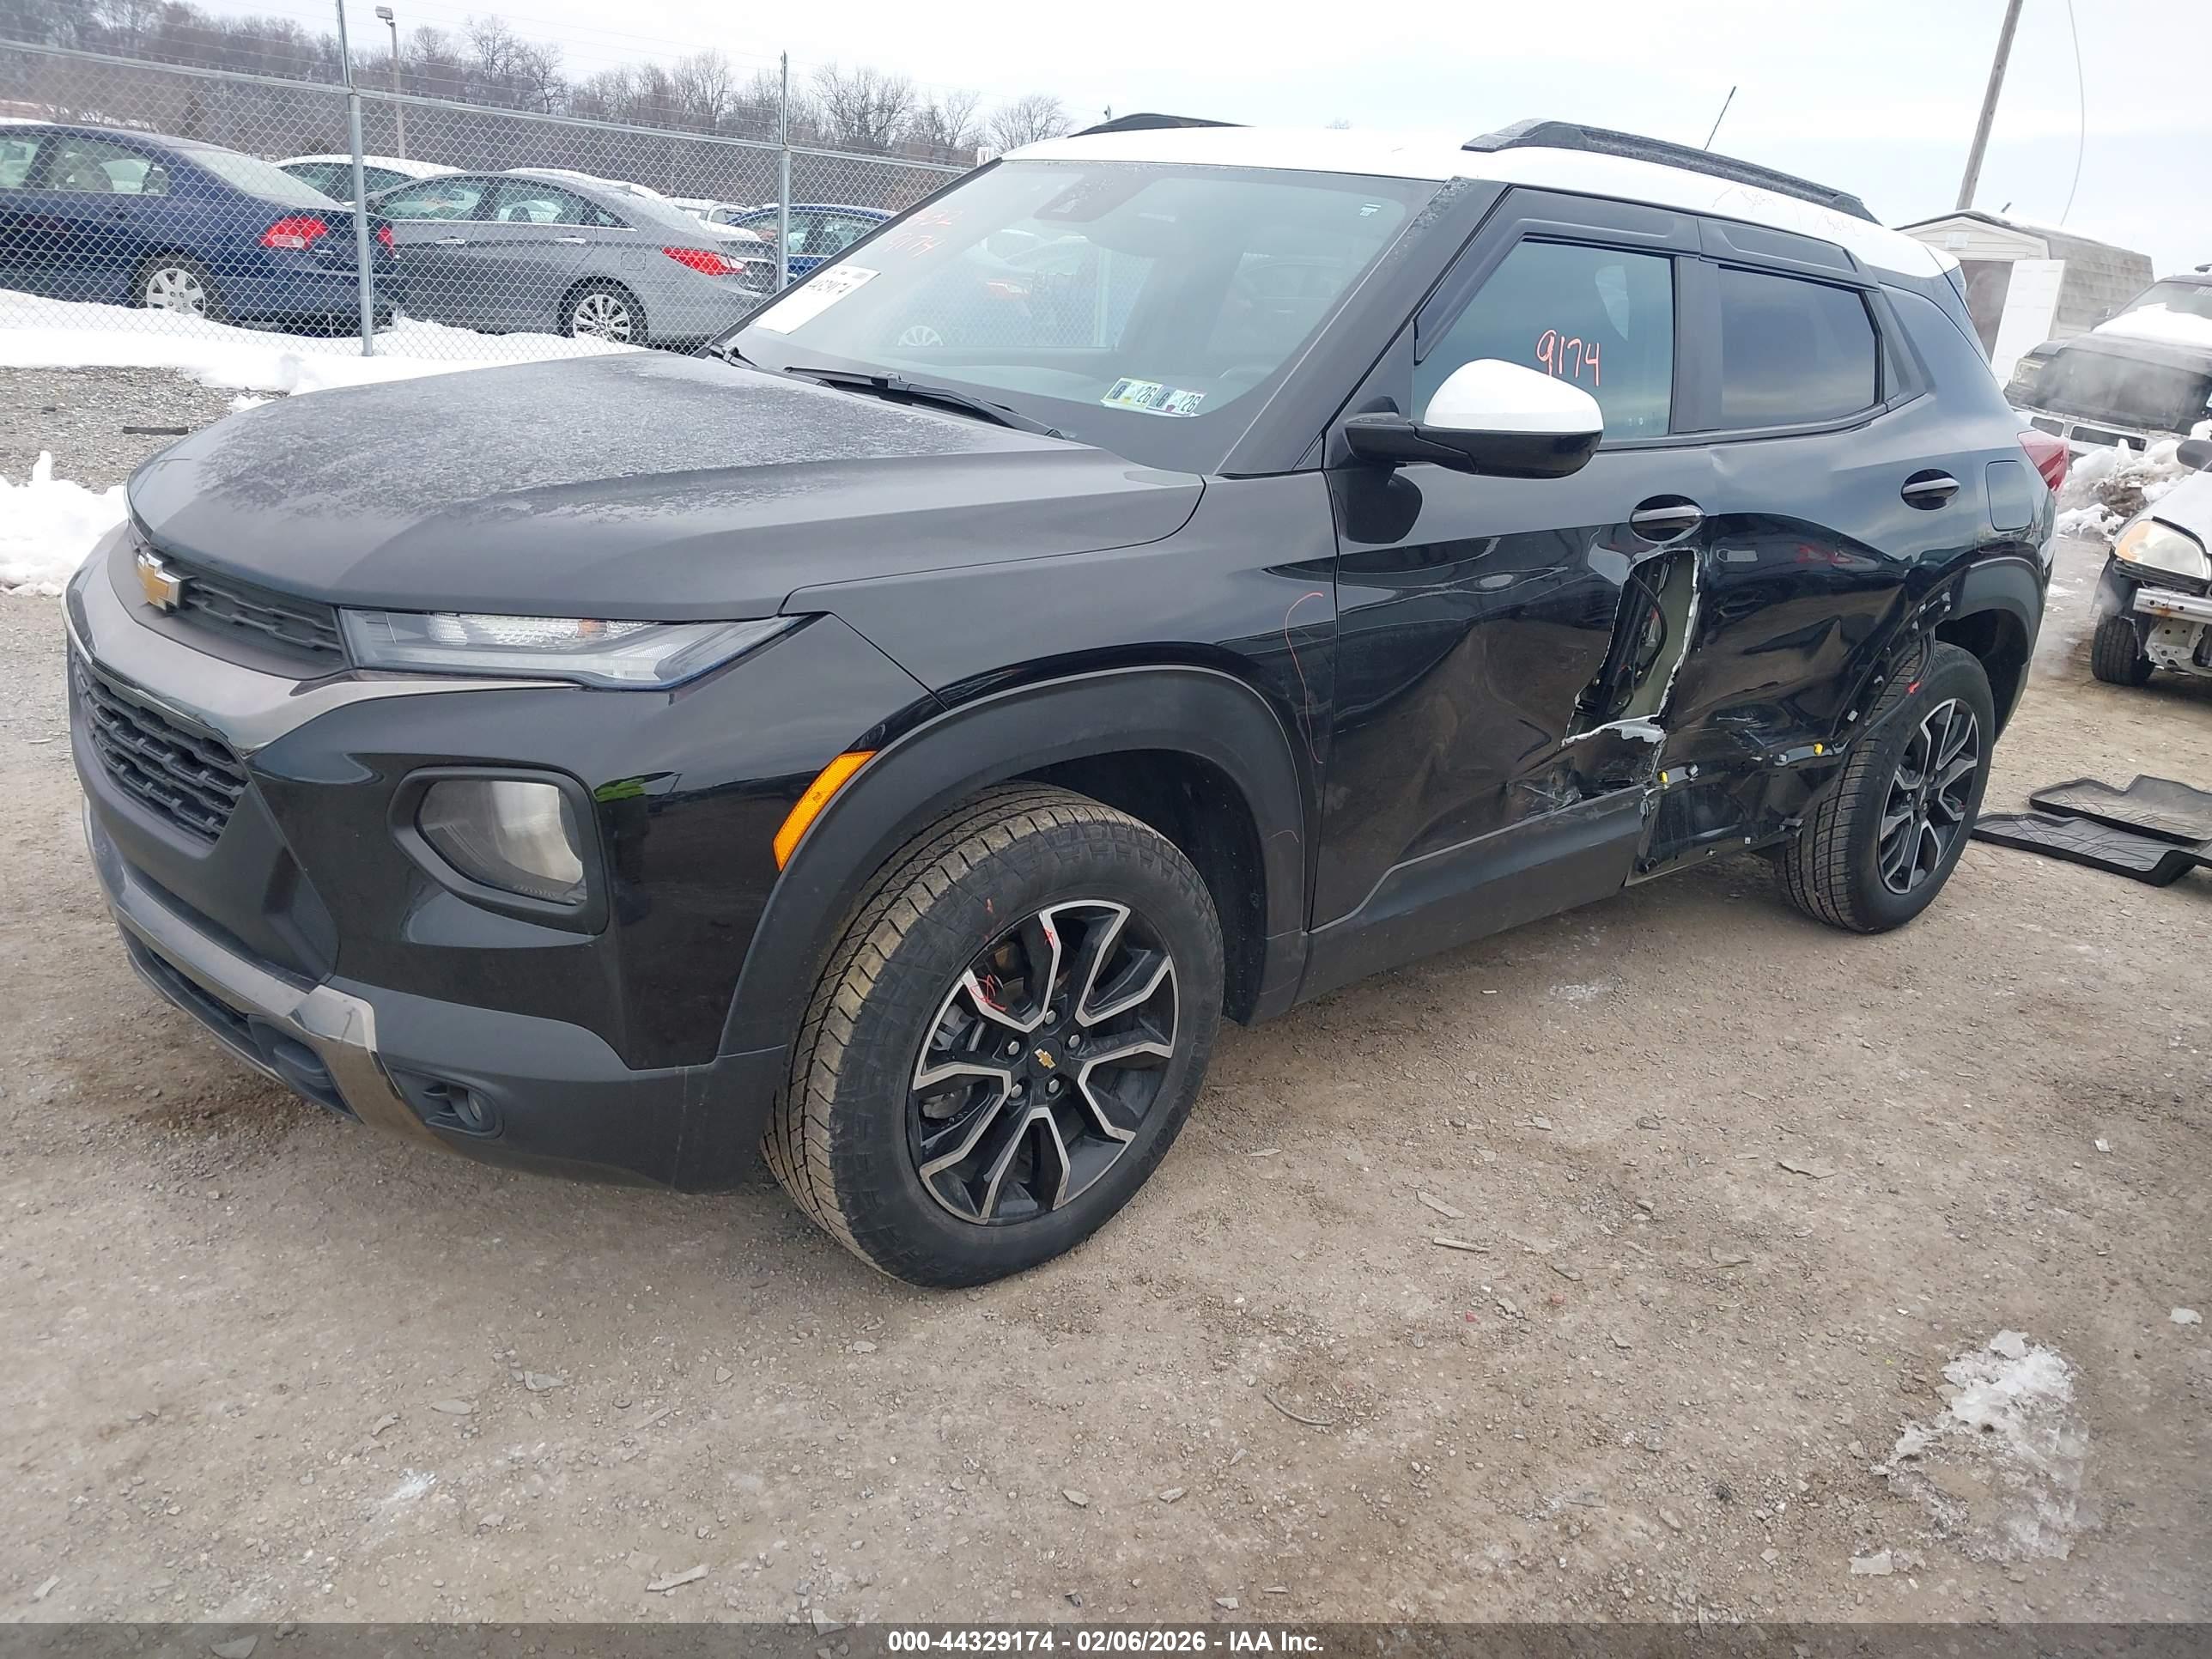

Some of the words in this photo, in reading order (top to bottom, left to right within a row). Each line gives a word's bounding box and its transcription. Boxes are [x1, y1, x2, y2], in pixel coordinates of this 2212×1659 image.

[1536, 329, 1600, 386] 9174
[1137, 386, 1158, 404] 26
[1181, 394, 1201, 412] 26
